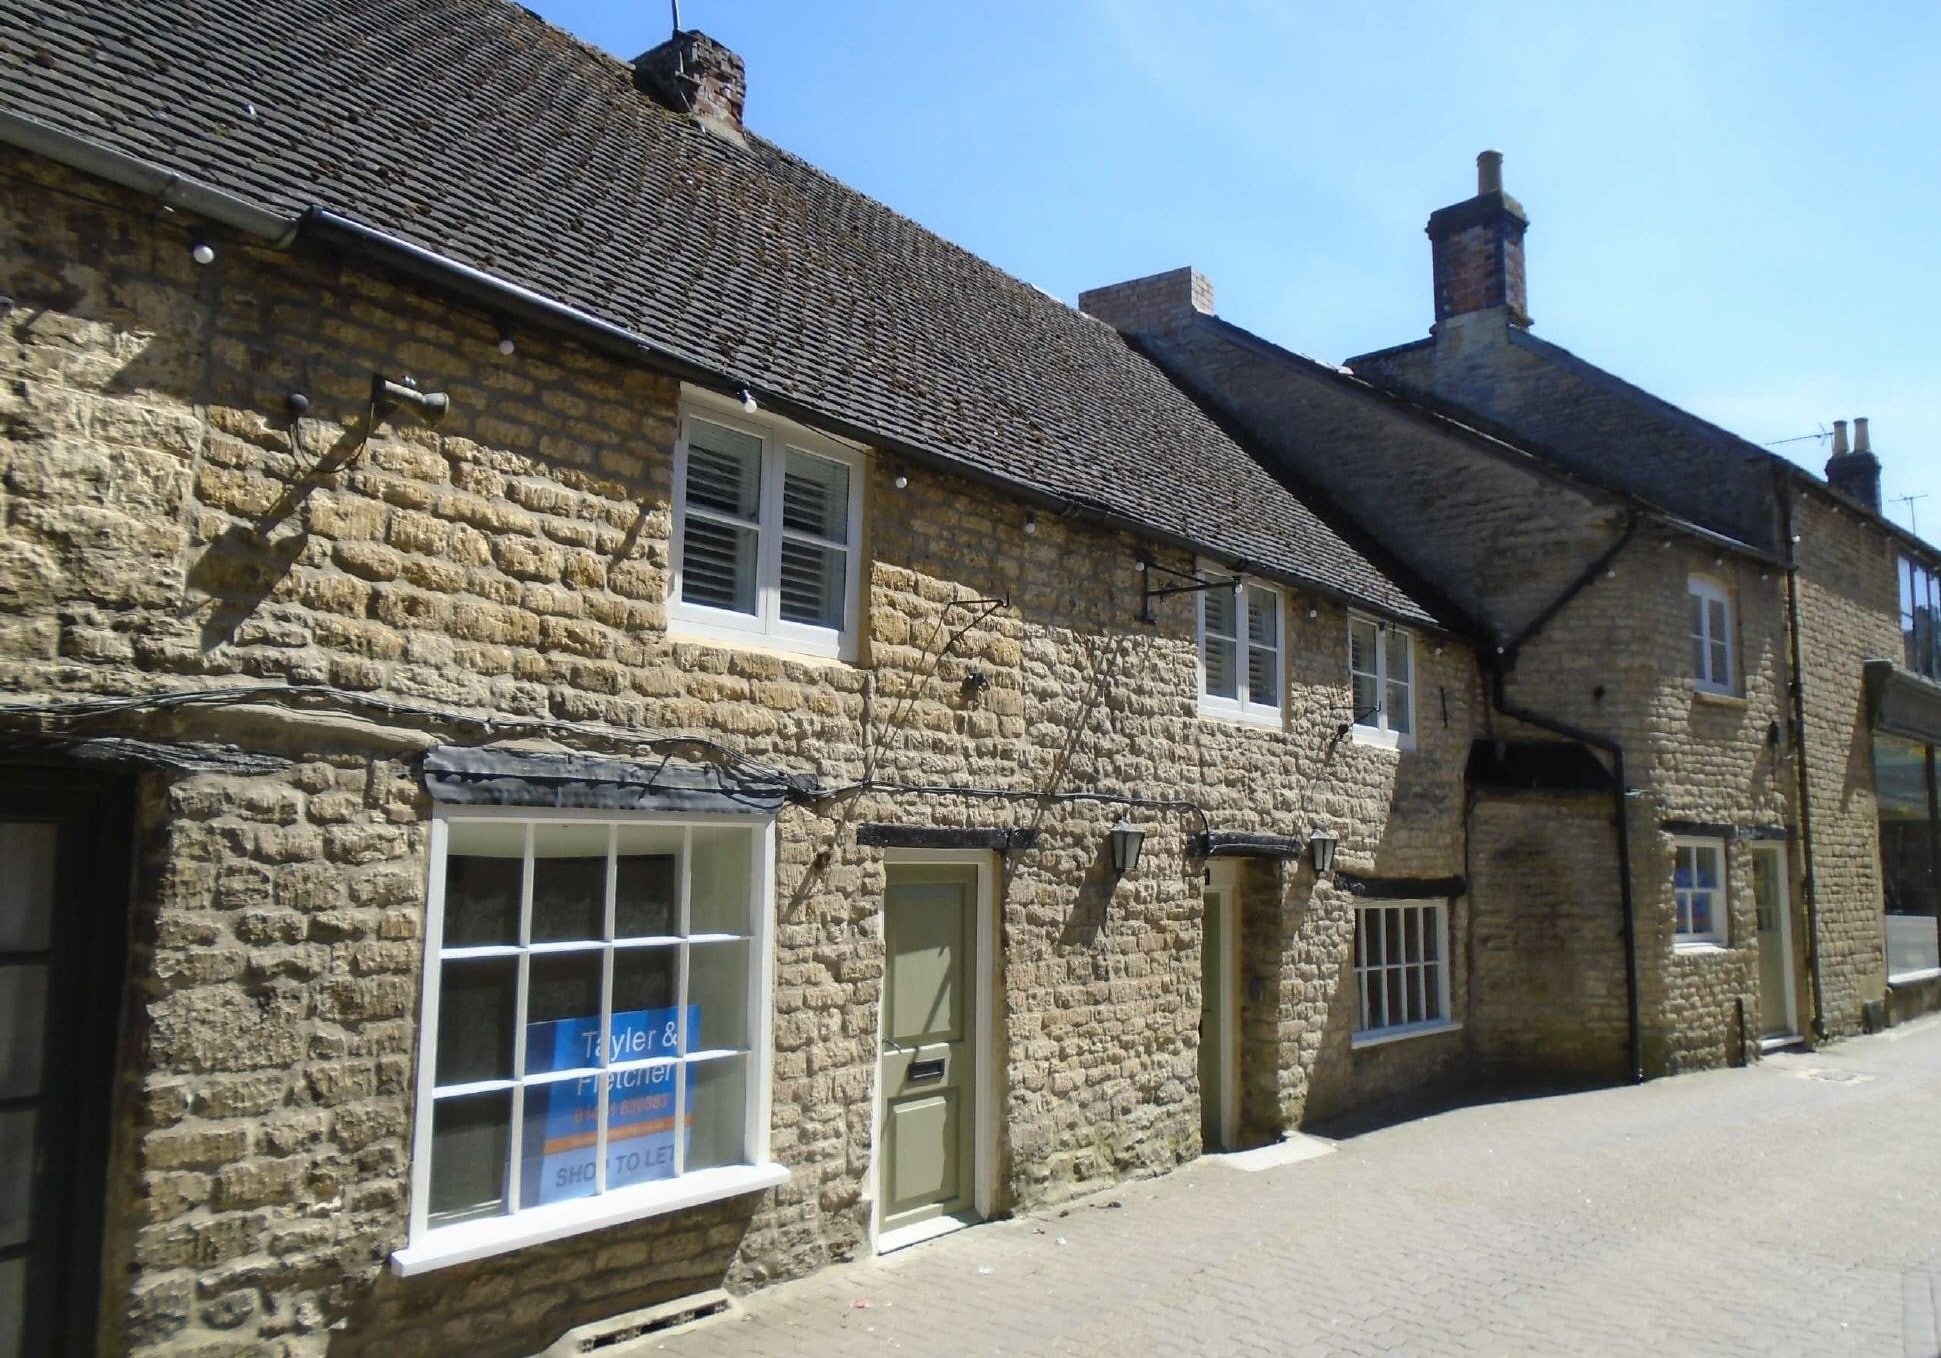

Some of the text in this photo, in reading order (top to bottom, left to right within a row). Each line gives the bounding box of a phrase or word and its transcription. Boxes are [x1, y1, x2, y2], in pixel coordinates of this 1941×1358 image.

[662, 1021, 677, 1047] &
[555, 1144, 675, 1188] SHO TO LET
